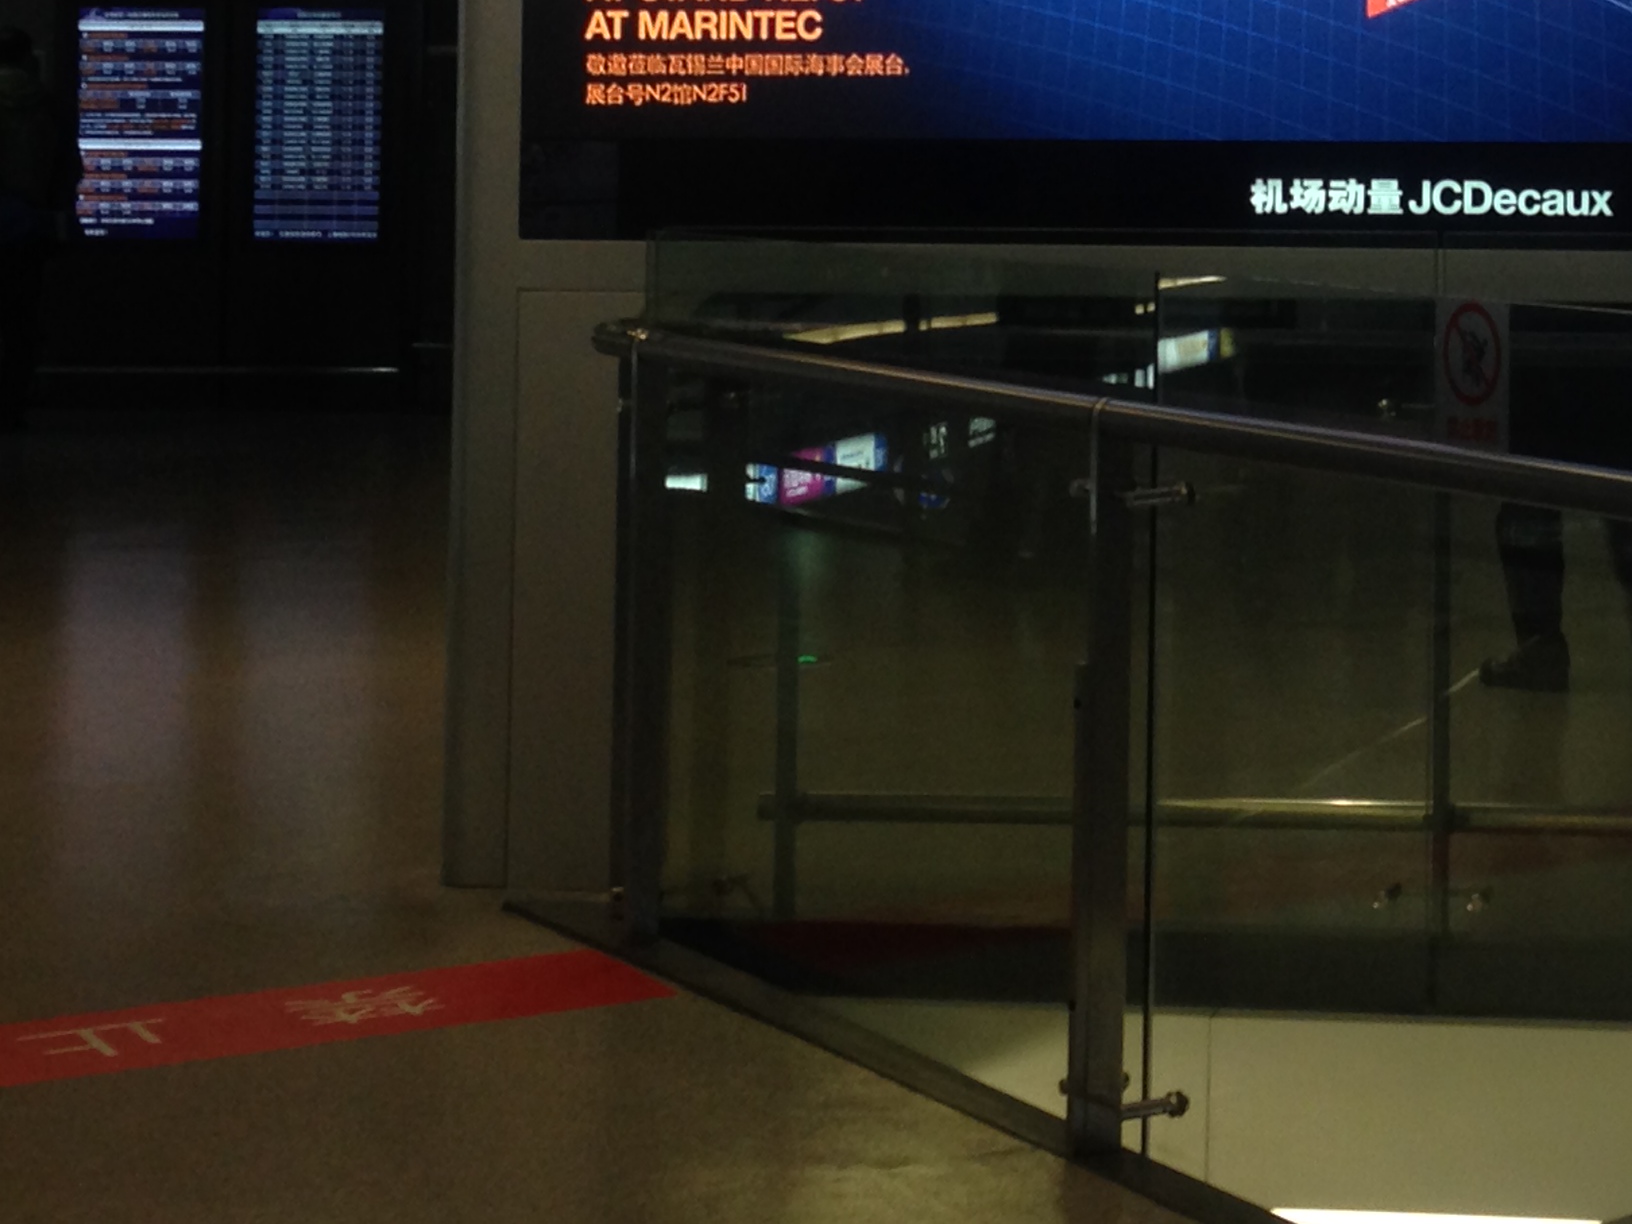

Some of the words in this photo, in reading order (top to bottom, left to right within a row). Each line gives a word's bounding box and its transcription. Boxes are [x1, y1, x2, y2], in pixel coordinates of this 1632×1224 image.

[585, 9, 630, 40] AT
[638, 9, 823, 41] MARINTEC
[1250, 178, 1403, 215] 机场动量
[1408, 180, 1613, 217] JCDecaux
